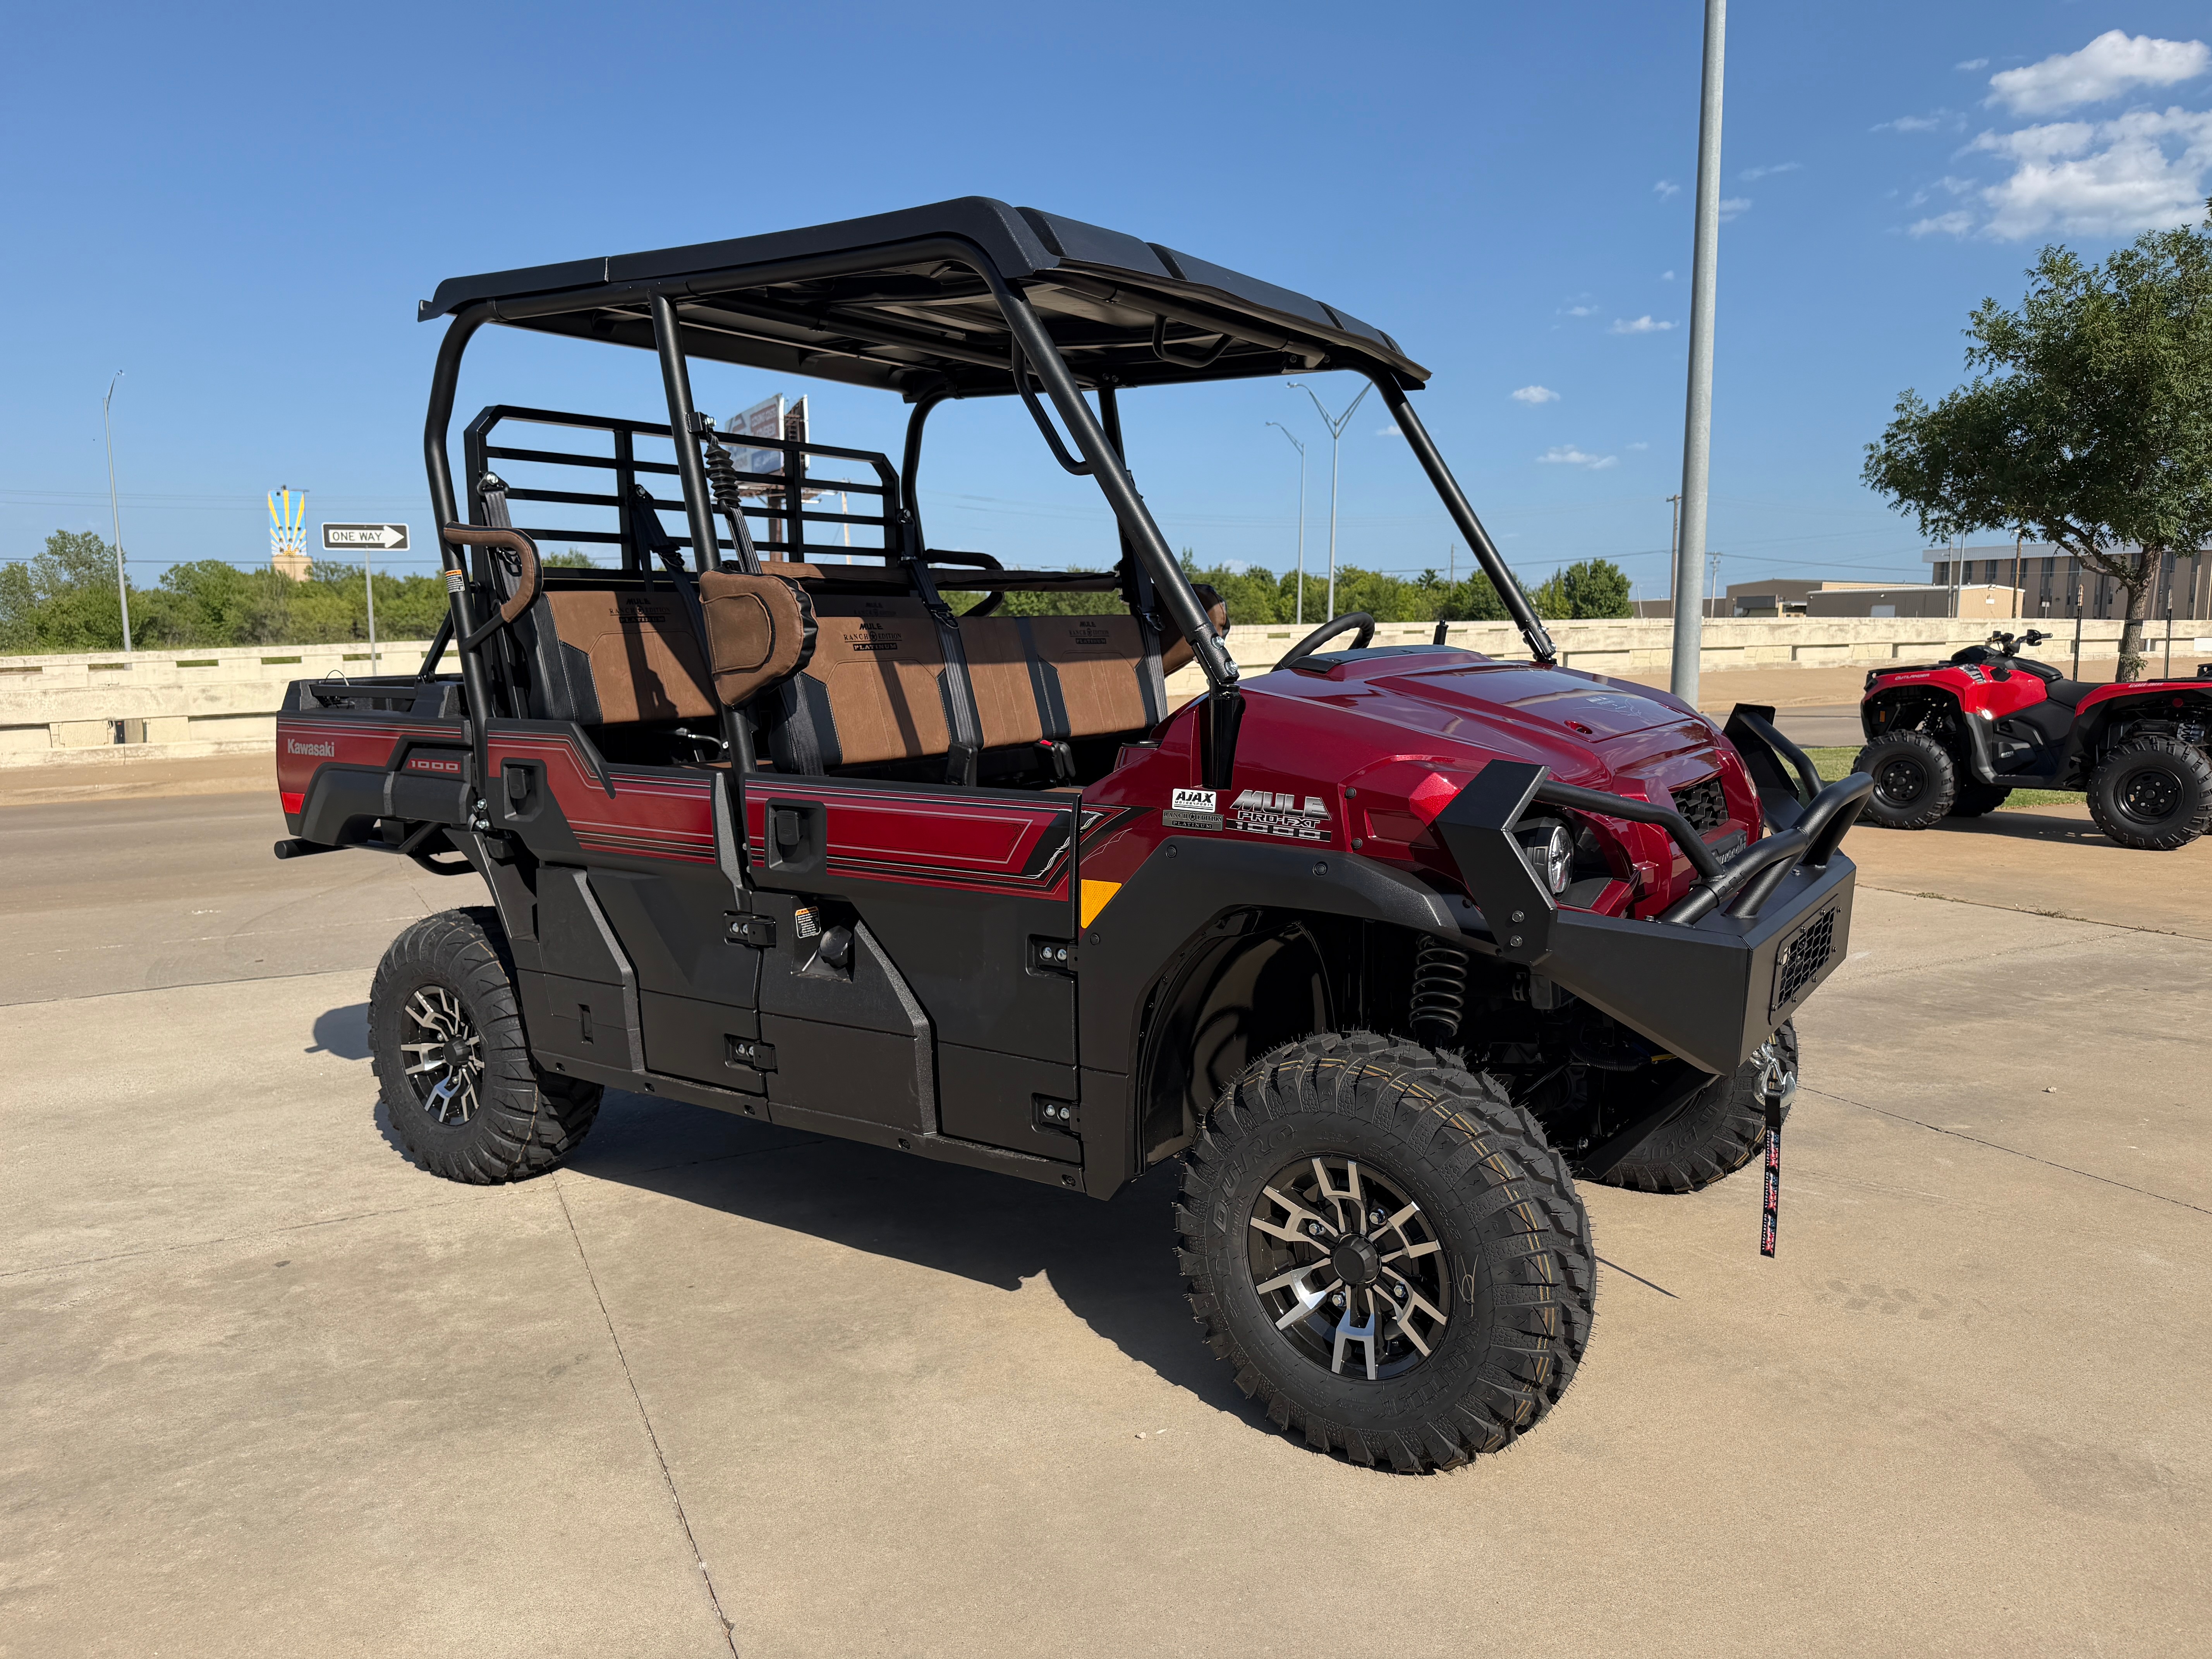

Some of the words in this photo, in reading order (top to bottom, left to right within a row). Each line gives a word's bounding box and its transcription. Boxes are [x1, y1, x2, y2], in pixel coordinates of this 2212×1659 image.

[332, 532, 355, 541] ONE
[359, 532, 382, 541] WAY
[287, 738, 335, 757] Kawasaki
[411, 760, 458, 771] 1000
[1175, 791, 1214, 803] AJAX
[1230, 790, 1332, 821] MULE
[1238, 811, 1320, 829] PRO-FXT
[1235, 821, 1321, 839] 1000
[1212, 1124, 1294, 1235] DURO
